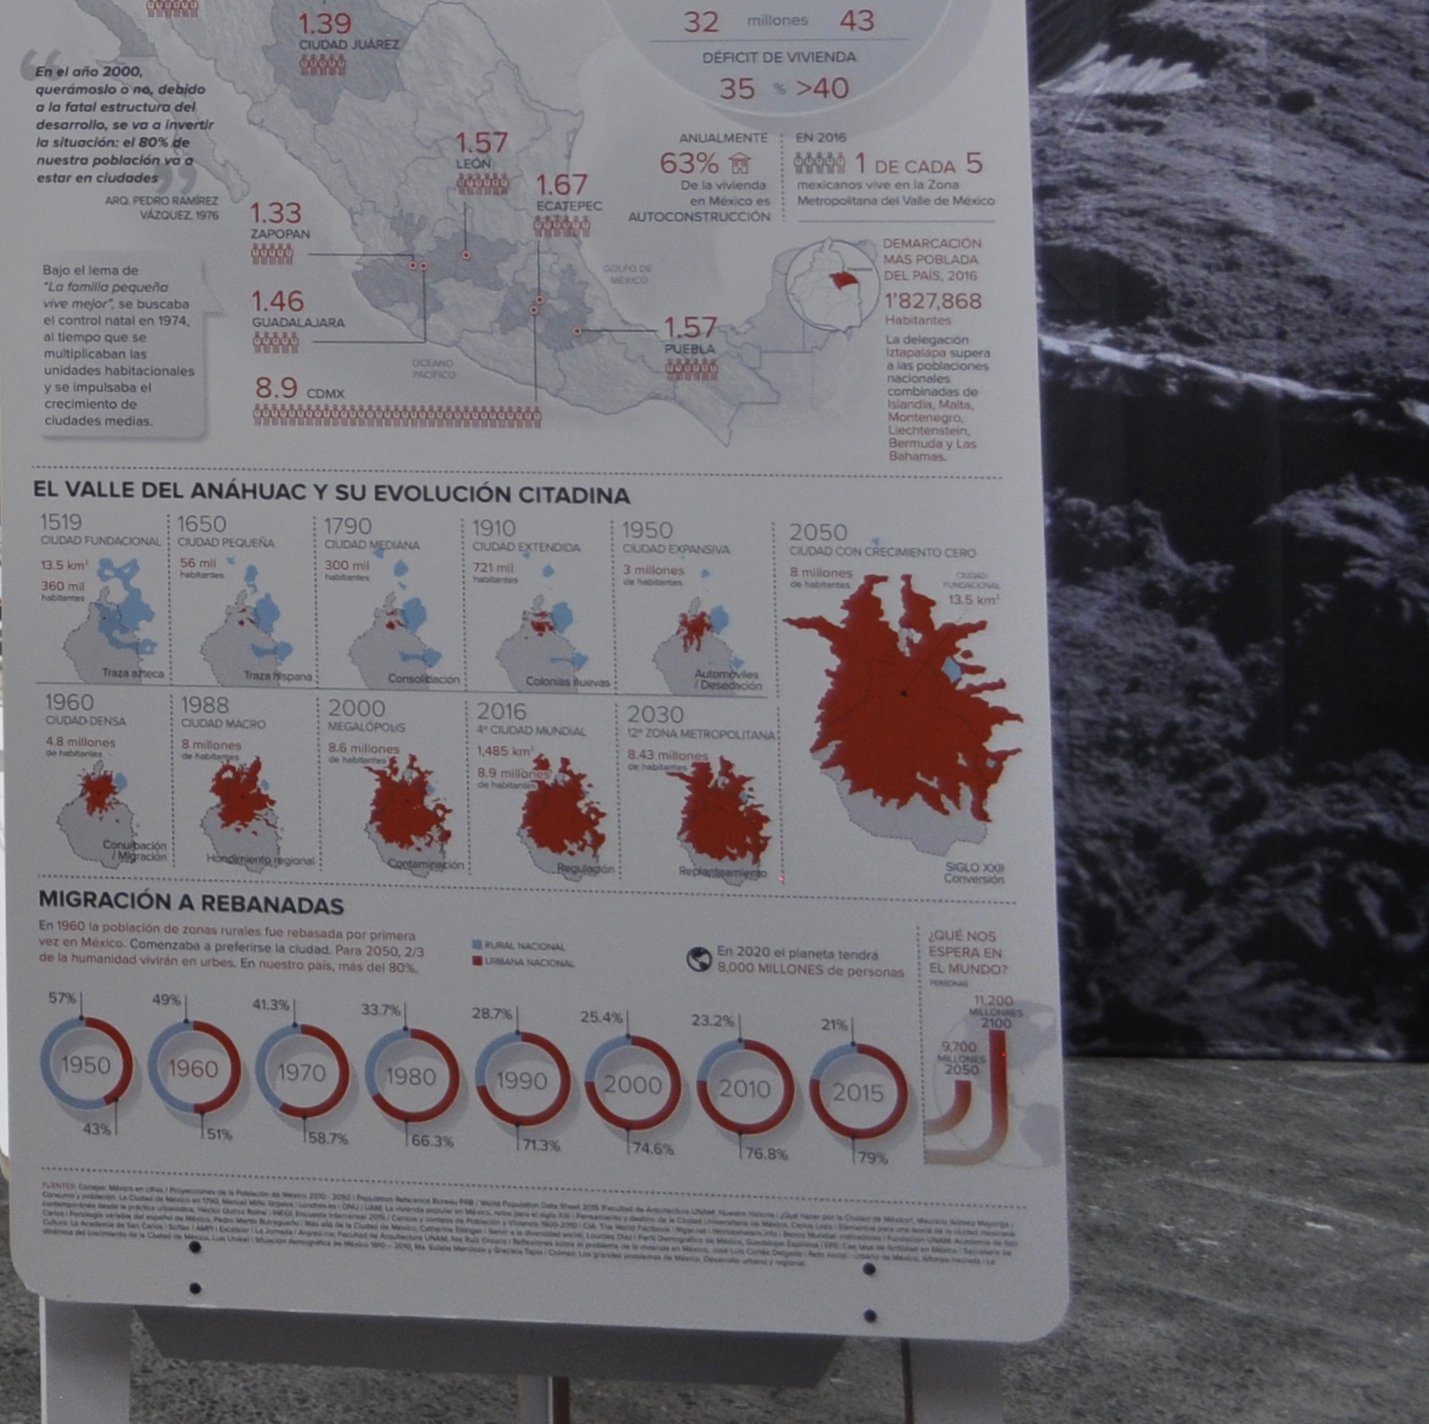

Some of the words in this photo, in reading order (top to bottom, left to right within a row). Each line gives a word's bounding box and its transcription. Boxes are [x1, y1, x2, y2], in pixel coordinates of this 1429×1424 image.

[299, 12, 352, 35] 1.39
[684, 10, 719, 33] 32
[747, 14, 809, 26] millones
[839, 9, 875, 32] 43
[298, 39, 349, 51] CIUDAD
[351, 37, 400, 51] JUÁREZ
[702, 50, 759, 64] DÉFICIT
[762, 51, 783, 64] DE
[786, 50, 857, 63] VIVIENDA
[35, 66, 53, 78] En
[56, 65, 69, 78] el
[72, 65, 99, 77] año
[102, 65, 143, 78] 2000,
[720, 77, 755, 100] 35
[797, 76, 850, 100] >40
[456, 130, 509, 154] 1.57
[679, 132, 768, 144] ANUALMENTE
[795, 132, 815, 143] EN
[816, 131, 848, 143] 2016
[456, 156, 491, 170] LEÓN
[660, 151, 720, 174] 63%
[855, 151, 865, 174] 1
[875, 159, 899, 174] DE
[904, 159, 957, 174] CADA
[966, 151, 983, 174] 5
[536, 173, 588, 196] 1.67
[250, 201, 302, 224] 1.33
[536, 200, 603, 212] ECATEPEC
[628, 210, 771, 223] AUTOCONSTRUCCIÓN
[250, 228, 311, 240] ZAPOPAN
[883, 237, 982, 249] DEMARCACIÓN
[883, 254, 913, 265] MÁS
[915, 254, 979, 266] POBLADA
[884, 270, 909, 282] DEL
[912, 268, 944, 282] PAÍS,
[947, 270, 978, 282] 2016
[252, 289, 304, 312] 1.46
[251, 316, 346, 328] GUADALAJARA
[664, 316, 718, 339] 1.57
[885, 314, 952, 326] Habitantes
[664, 343, 716, 355] PUEBLA
[255, 376, 298, 399] 8.9
[306, 388, 345, 399] CDMX
[33, 480, 59, 497] EL
[64, 480, 135, 498] VALLE
[141, 481, 184, 499] DEL
[190, 479, 307, 500] ANÁHUAC
[313, 483, 329, 501] Y
[335, 483, 366, 502] SU
[374, 482, 511, 503] EVOLUCIÓN
[518, 486, 631, 504] CITADINA
[40, 512, 82, 531] 1519
[177, 514, 227, 533] 1650
[324, 516, 373, 535] 1790
[472, 518, 516, 537] 1910
[622, 520, 674, 540] 1950
[789, 523, 848, 542] 2050
[45, 692, 95, 711] 1960
[181, 695, 230, 714] 1988
[328, 698, 386, 717] 2000
[477, 702, 527, 721] 2016
[627, 704, 685, 724] 2030
[39, 887, 171, 910] MIGRACIÓN
[178, 893, 195, 911] A
[201, 895, 345, 915] REBANADAS
[928, 928, 963, 944] ¿QUÉ
[966, 930, 997, 943] NOS
[717, 945, 734, 957] En
[736, 945, 771, 958] 2020
[773, 947, 786, 959] el
[788, 948, 835, 961] planeta
[838, 949, 879, 961] tendrá
[929, 946, 981, 958] ESPERA
[983, 947, 1003, 959] EN
[717, 961, 755, 975] 8,000
[758, 963, 825, 976] MILLONES
[826, 965, 844, 977] de
[847, 968, 905, 980] personas
[929, 962, 945, 974] EL
[948, 963, 1008, 975] MUNDO?
[48, 991, 77, 1005] 57%
[151, 993, 182, 1006] 49%
[252, 998, 291, 1011] 41.3%
[361, 1003, 402, 1017] 33.7%
[472, 1007, 513, 1020] 28.7%
[580, 1010, 624, 1024] 25.4%
[691, 1014, 736, 1028] 23.2%
[821, 1018, 849, 1032] 21%
[61, 1054, 111, 1075] 1950
[168, 1058, 219, 1078] 1960
[277, 1061, 327, 1082] 1970
[386, 1065, 437, 1087] 1980
[495, 1069, 548, 1091] 1990
[603, 1074, 663, 1095] 2000
[719, 1077, 771, 1099] 2010
[832, 1081, 885, 1103] 2015
